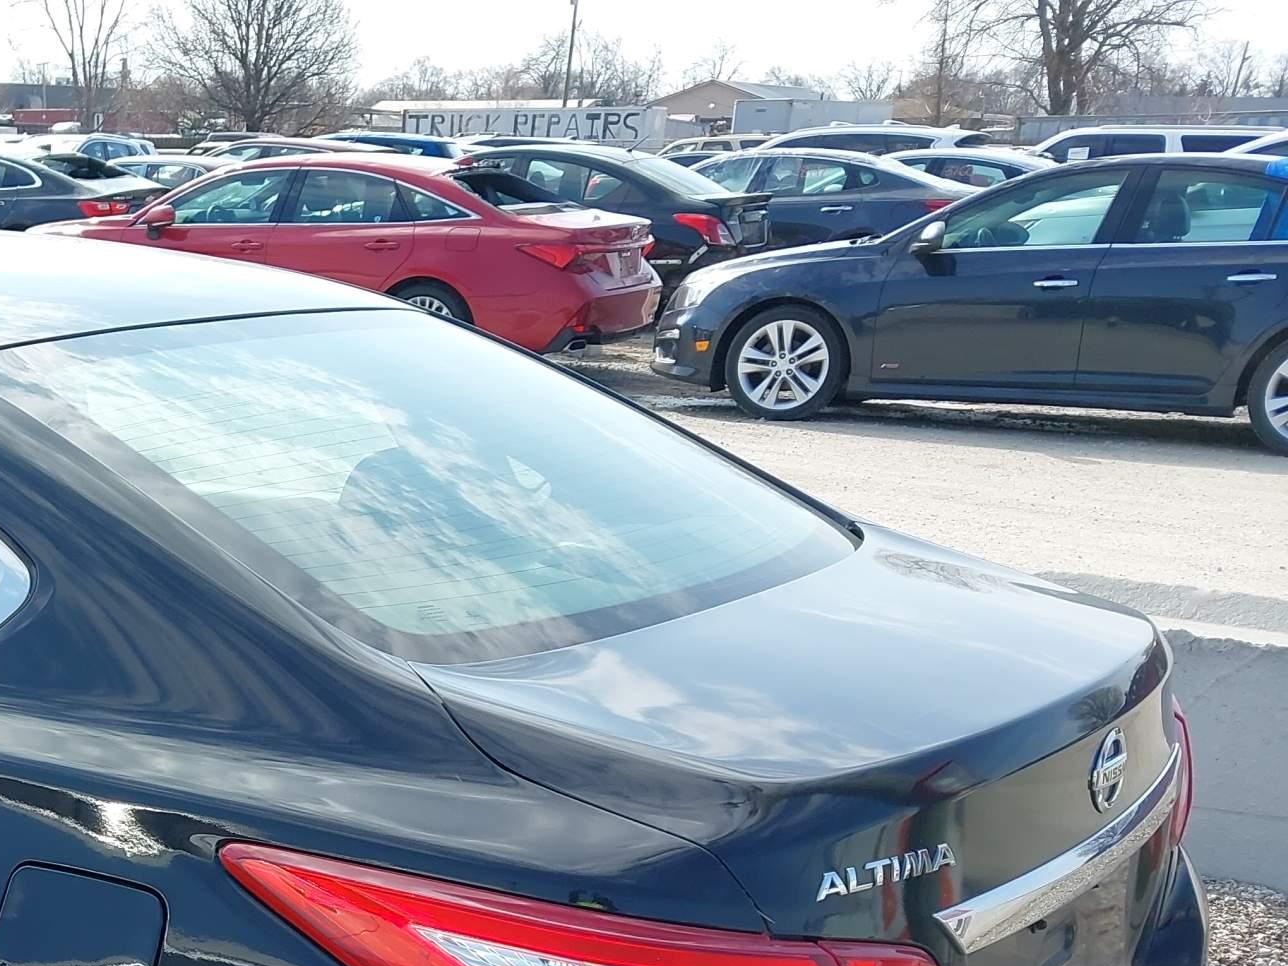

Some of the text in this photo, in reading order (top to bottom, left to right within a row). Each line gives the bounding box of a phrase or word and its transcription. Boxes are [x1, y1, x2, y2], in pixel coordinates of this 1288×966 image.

[512, 112, 641, 140] REPAIRS
[1102, 759, 1127, 785] NISS
[816, 843, 956, 902] ALTIMA
